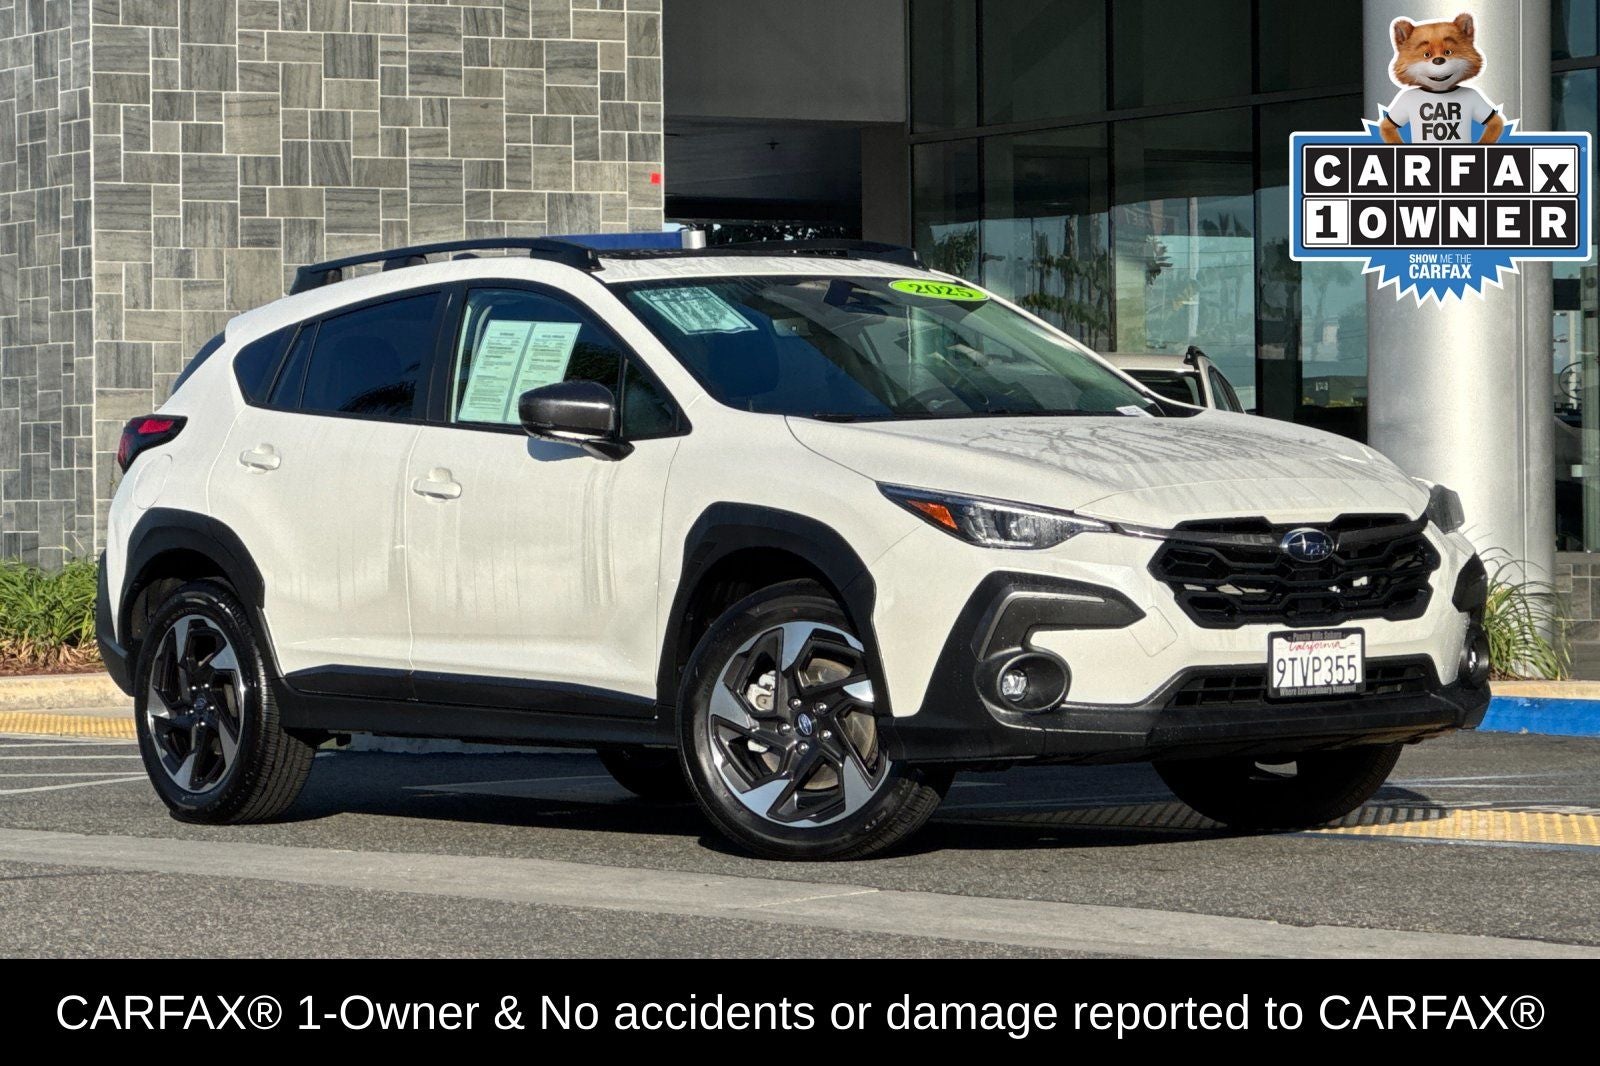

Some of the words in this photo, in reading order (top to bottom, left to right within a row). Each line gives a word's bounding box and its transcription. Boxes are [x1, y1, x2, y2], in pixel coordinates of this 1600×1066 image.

[909, 283, 974, 298] 2025
[1288, 640, 1346, 655] California
[1276, 654, 1357, 688] 9TVP355
